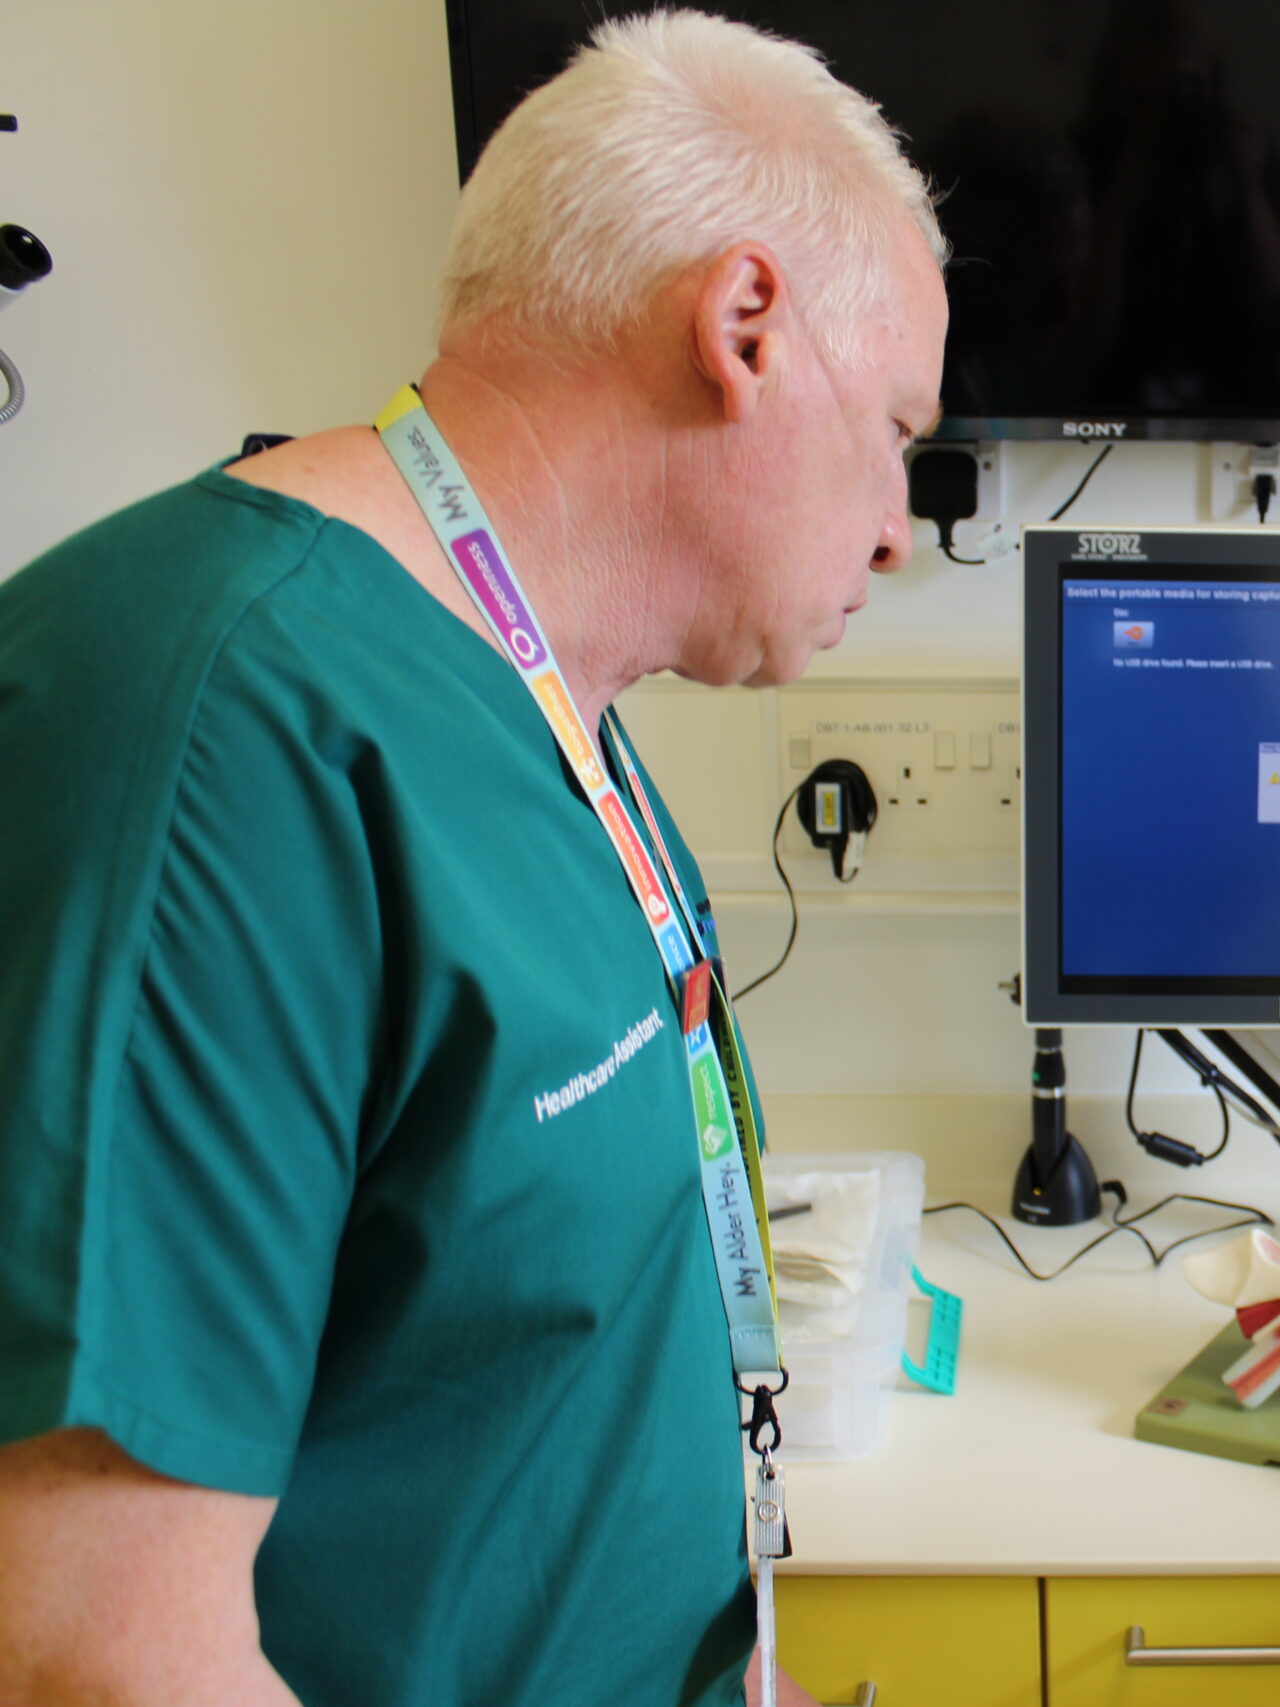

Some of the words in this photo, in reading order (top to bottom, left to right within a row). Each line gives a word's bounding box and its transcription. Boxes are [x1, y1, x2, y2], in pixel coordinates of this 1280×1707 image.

[1062, 422, 1126, 436] SONY
[437, 485, 468, 522] My
[1078, 533, 1142, 555] STORZ
[467, 541, 517, 625] openness
[1066, 587, 1098, 599] Select
[1100, 588, 1117, 598] the
[1119, 588, 1161, 601] portable
[1163, 588, 1195, 599] media
[1196, 590, 1211, 599] for
[1213, 590, 1250, 602] storing
[543, 683, 585, 756] together
[607, 801, 652, 892] innovation
[534, 1055, 615, 1123] Healthcare
[613, 1006, 664, 1070] Assistant
[699, 1062, 718, 1122] respect
[716, 1162, 741, 1211] Hey.
[724, 1212, 749, 1261] Alder
[734, 1266, 761, 1298] My
